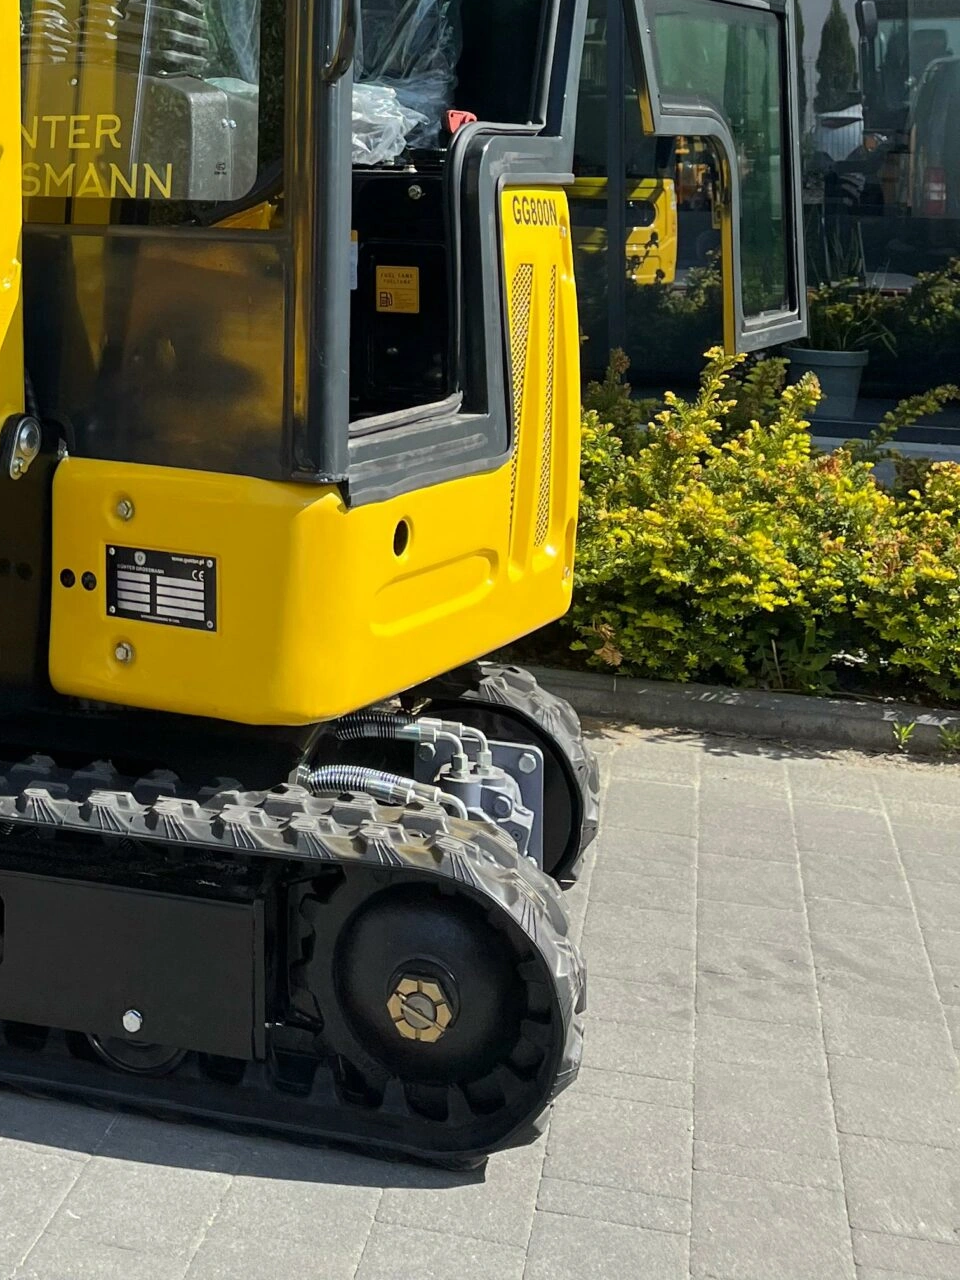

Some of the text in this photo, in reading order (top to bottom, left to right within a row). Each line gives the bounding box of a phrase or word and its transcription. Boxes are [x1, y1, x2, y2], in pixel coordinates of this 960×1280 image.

[21, 114, 121, 149] NTER
[22, 162, 173, 199] SMANN
[512, 195, 558, 227] GG800N
